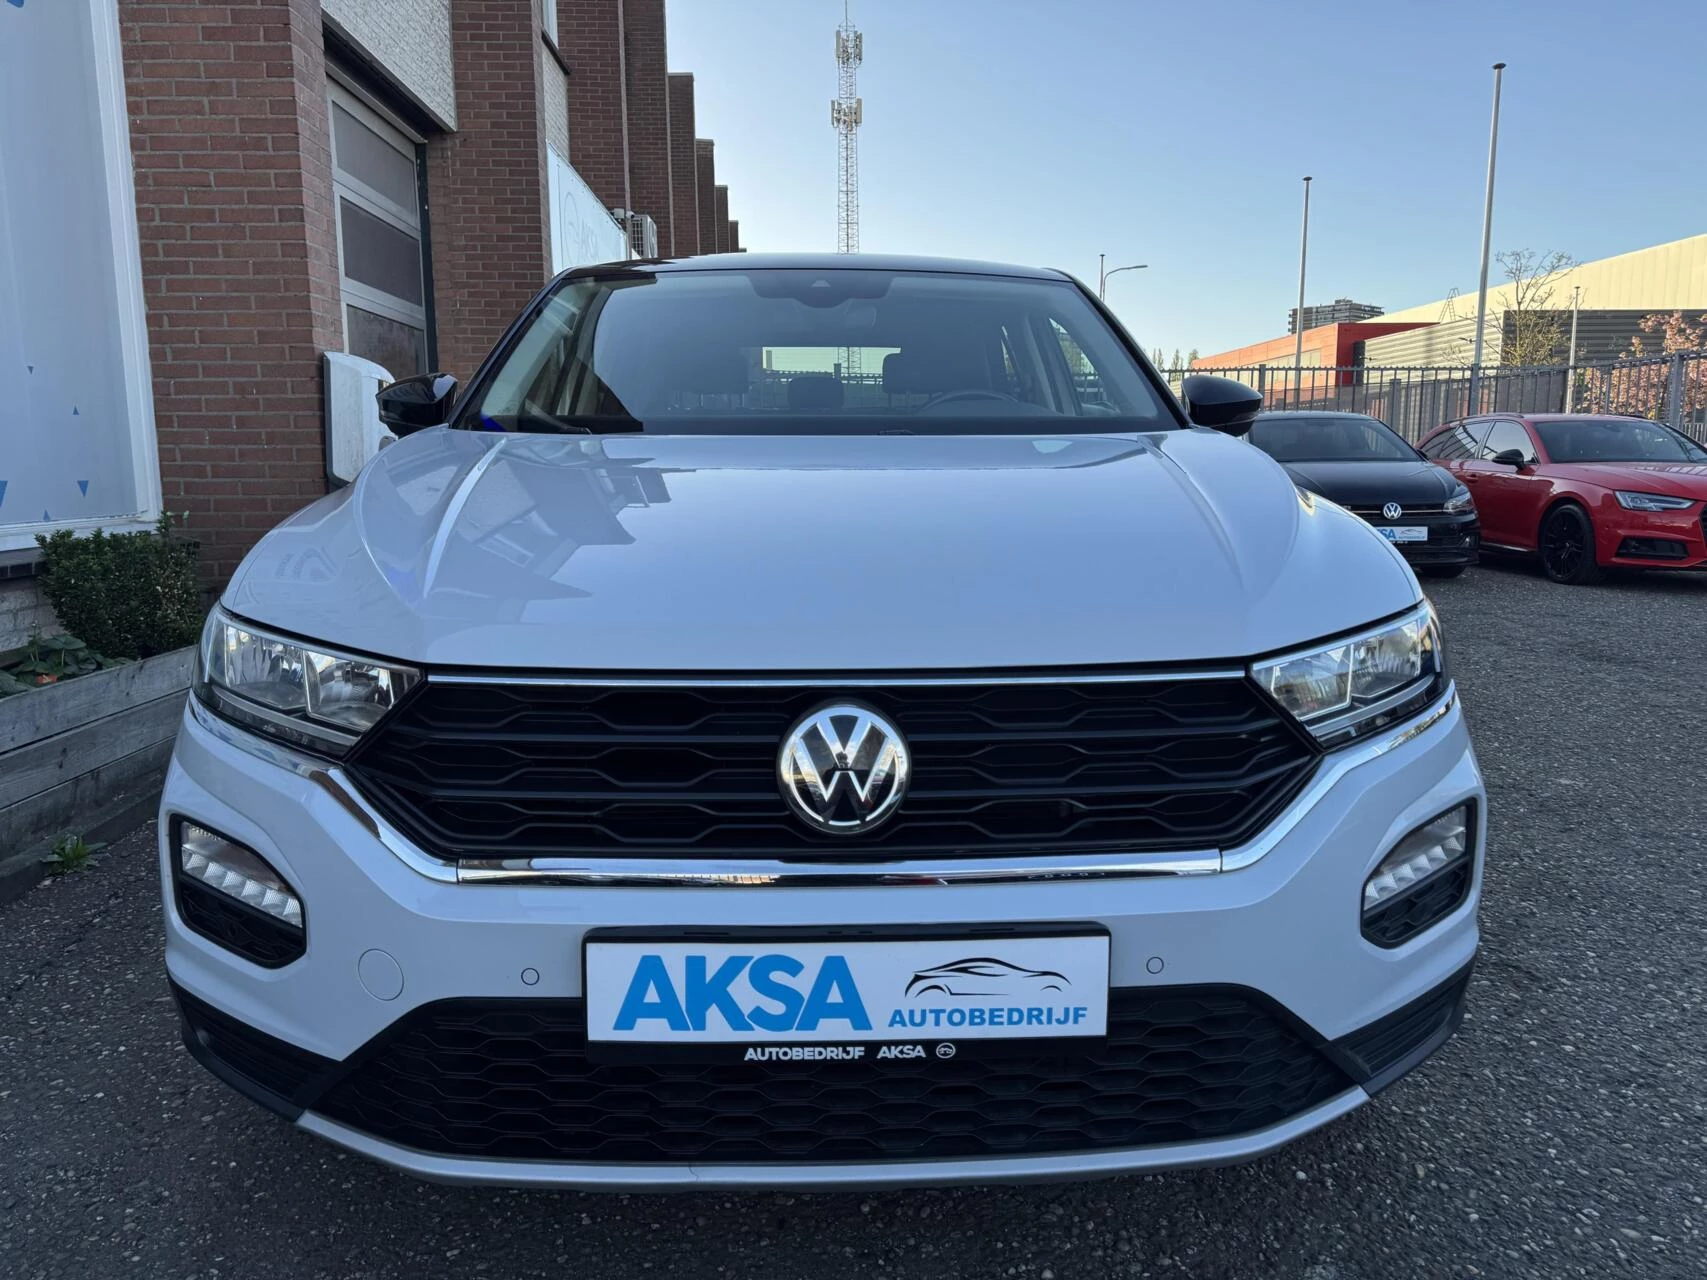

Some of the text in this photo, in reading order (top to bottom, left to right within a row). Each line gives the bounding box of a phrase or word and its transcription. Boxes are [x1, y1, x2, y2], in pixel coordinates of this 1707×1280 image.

[782, 706, 908, 834] VW
[614, 954, 872, 1031] AKSA
[888, 1007, 1087, 1027] AUTOBEDRIJF
[744, 1046, 926, 1060] AUTOBEDRIJF AKSA
